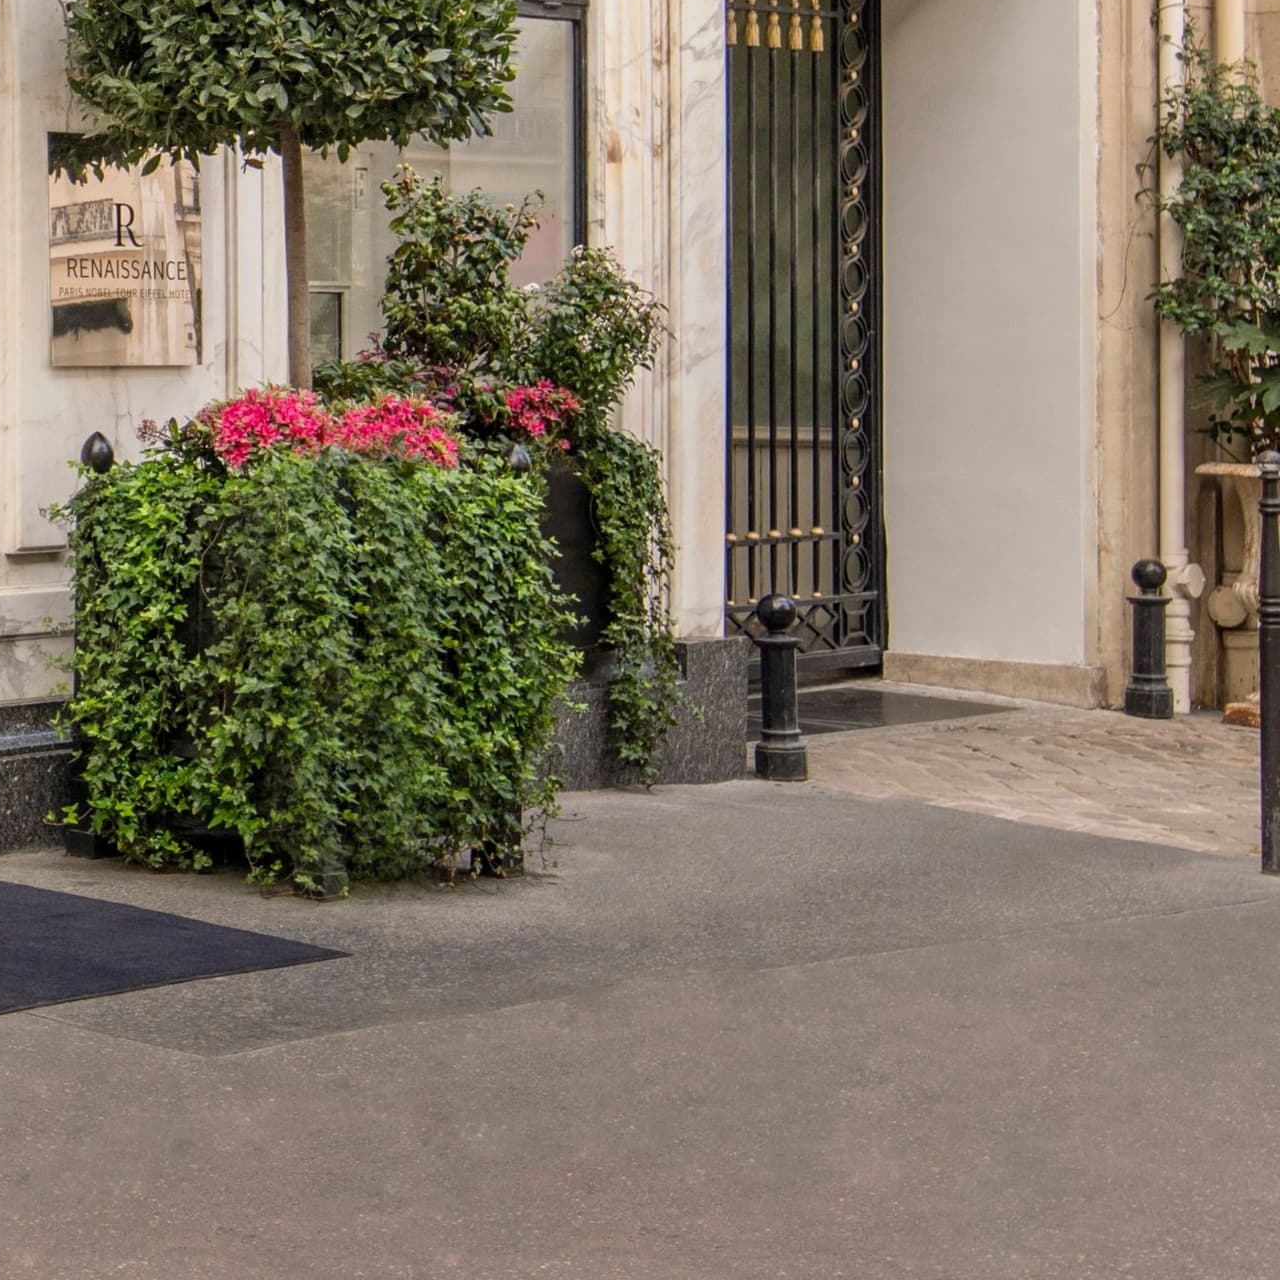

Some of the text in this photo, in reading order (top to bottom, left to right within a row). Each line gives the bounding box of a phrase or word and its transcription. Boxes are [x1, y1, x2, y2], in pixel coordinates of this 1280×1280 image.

[114, 202, 144, 248] R
[67, 257, 187, 281] RENAISSANCE
[58, 287, 83, 297] PARIS
[86, 287, 112, 298] NOBEL
